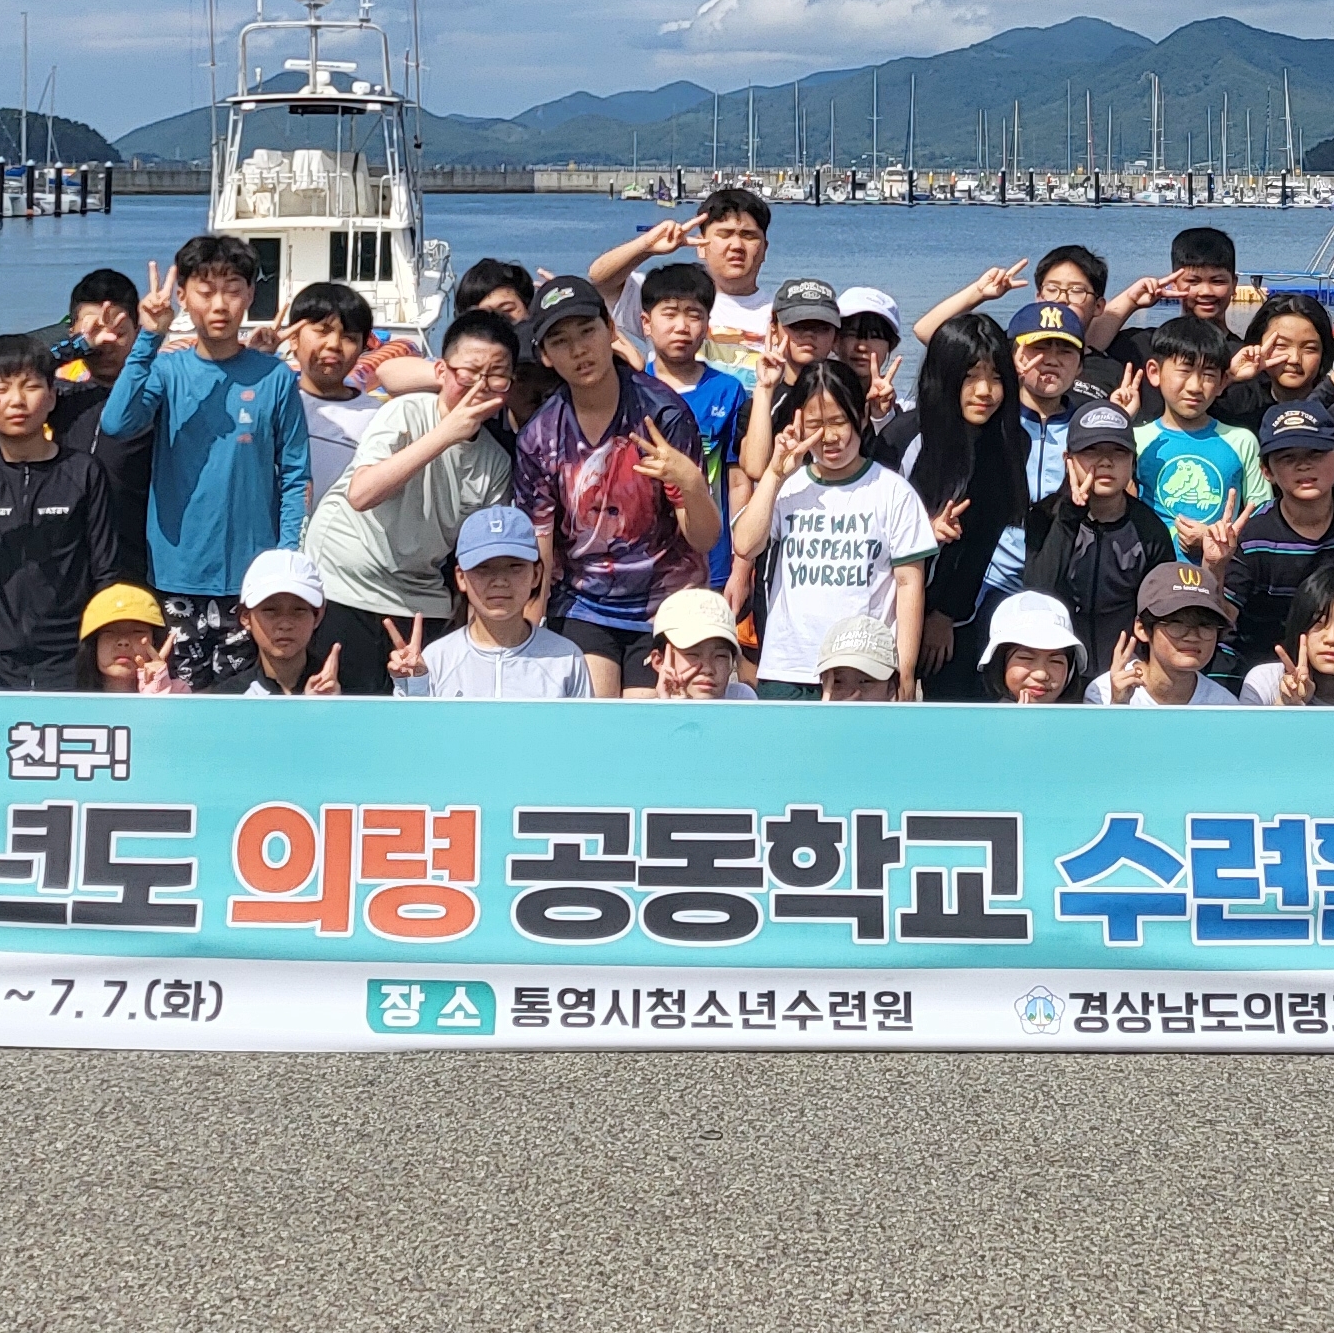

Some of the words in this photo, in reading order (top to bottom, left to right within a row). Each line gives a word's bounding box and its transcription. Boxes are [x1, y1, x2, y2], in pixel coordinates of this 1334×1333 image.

[785, 513, 826, 534] THE
[831, 512, 873, 535] WAY
[806, 538, 864, 561] SPEAK
[865, 539, 883, 560] TO
[788, 561, 874, 589] YOURSELF
[7, 722, 131, 781] 친구!
[226, 801, 482, 943] 의령
[506, 804, 1033, 947] 공동학교
[49, 979, 83, 1018] 7.
[102, 978, 224, 1022] 7.(화)
[511, 986, 914, 1031] 통영시청소년수련원
